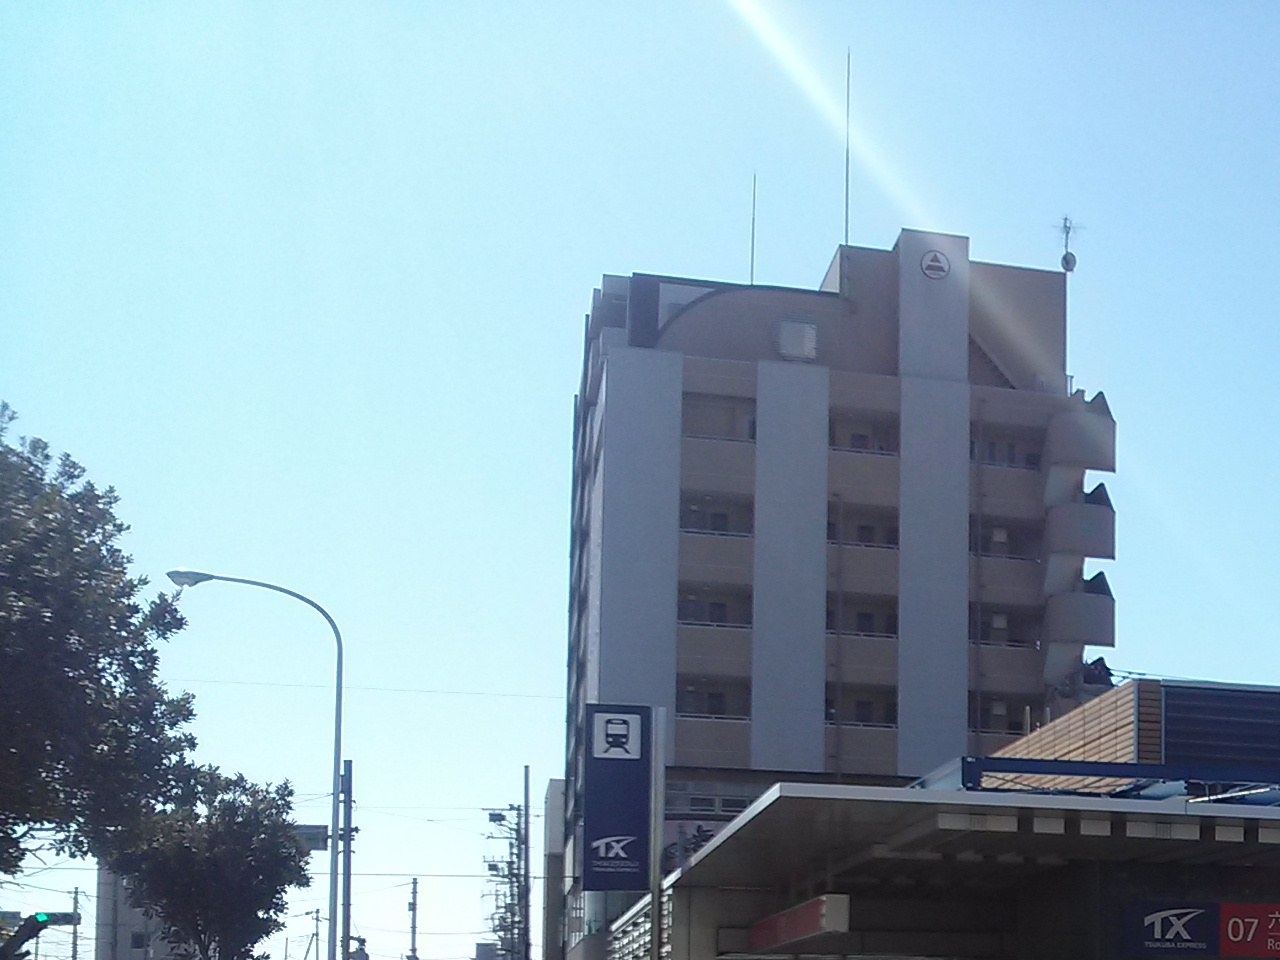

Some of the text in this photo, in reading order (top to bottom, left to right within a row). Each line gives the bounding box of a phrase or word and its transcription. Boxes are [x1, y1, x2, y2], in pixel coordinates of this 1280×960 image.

[591, 836, 637, 858] TX
[1144, 908, 1206, 940] TX
[1227, 917, 1260, 942] 07
